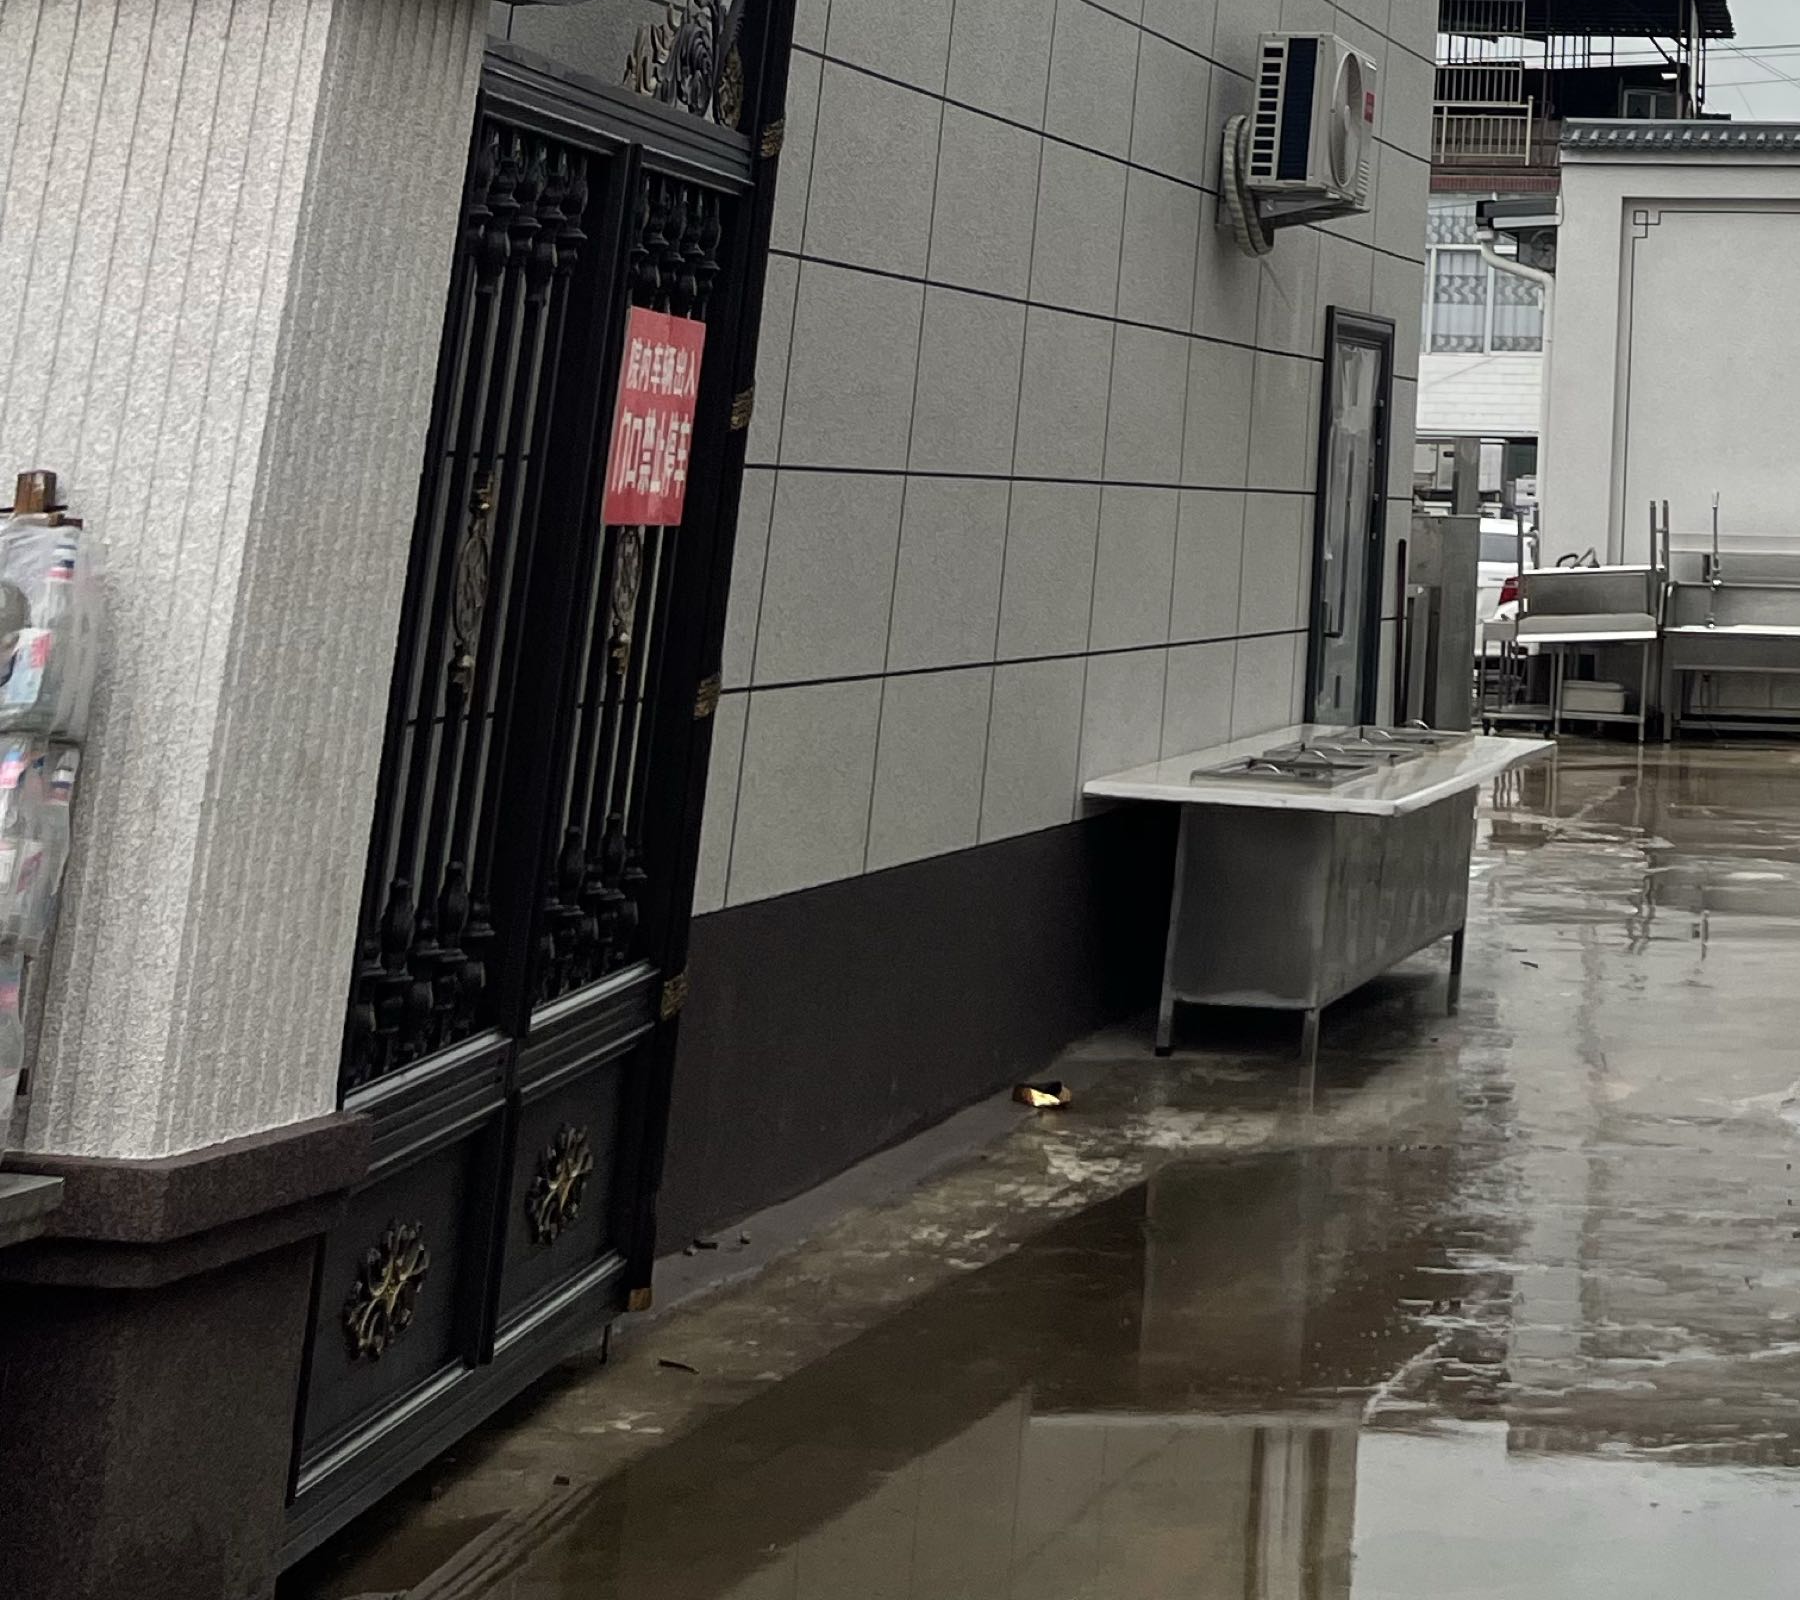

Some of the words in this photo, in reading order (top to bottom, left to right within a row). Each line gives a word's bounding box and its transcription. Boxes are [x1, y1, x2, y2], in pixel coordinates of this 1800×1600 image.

[612, 407, 691, 499] 门口禁止停车
